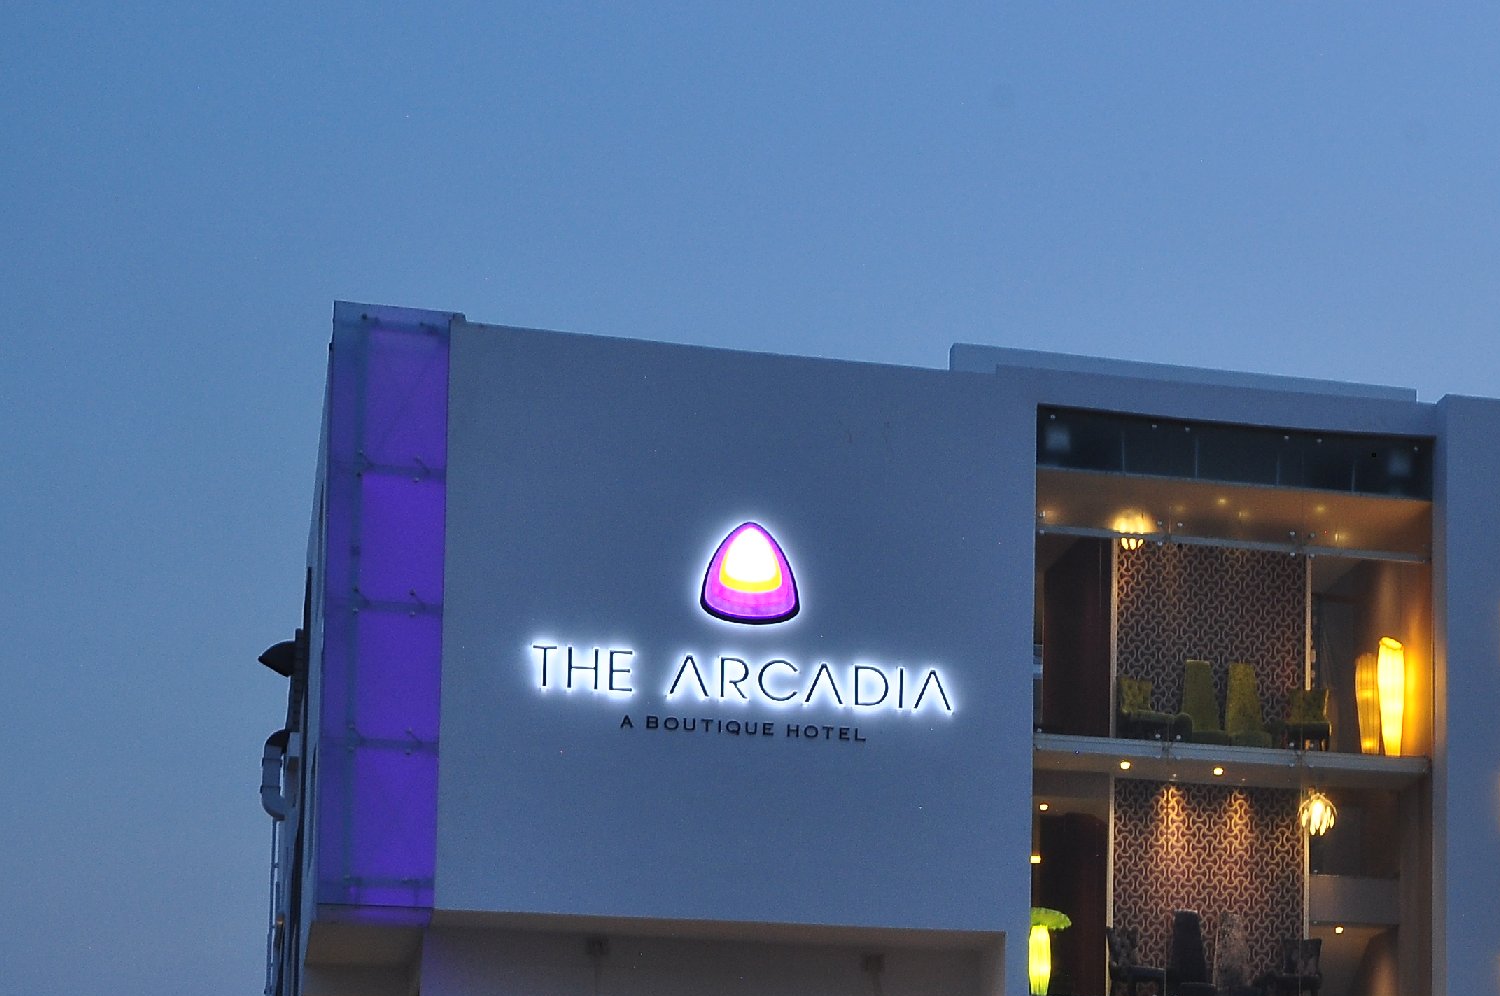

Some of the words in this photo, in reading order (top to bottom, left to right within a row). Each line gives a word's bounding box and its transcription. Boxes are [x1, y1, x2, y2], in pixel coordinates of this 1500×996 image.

[532, 644, 634, 693] THE
[668, 654, 954, 712] ARCADIA
[620, 714, 634, 730] A
[646, 715, 774, 737] BOUTIQUE
[786, 724, 867, 742] HOTEL
